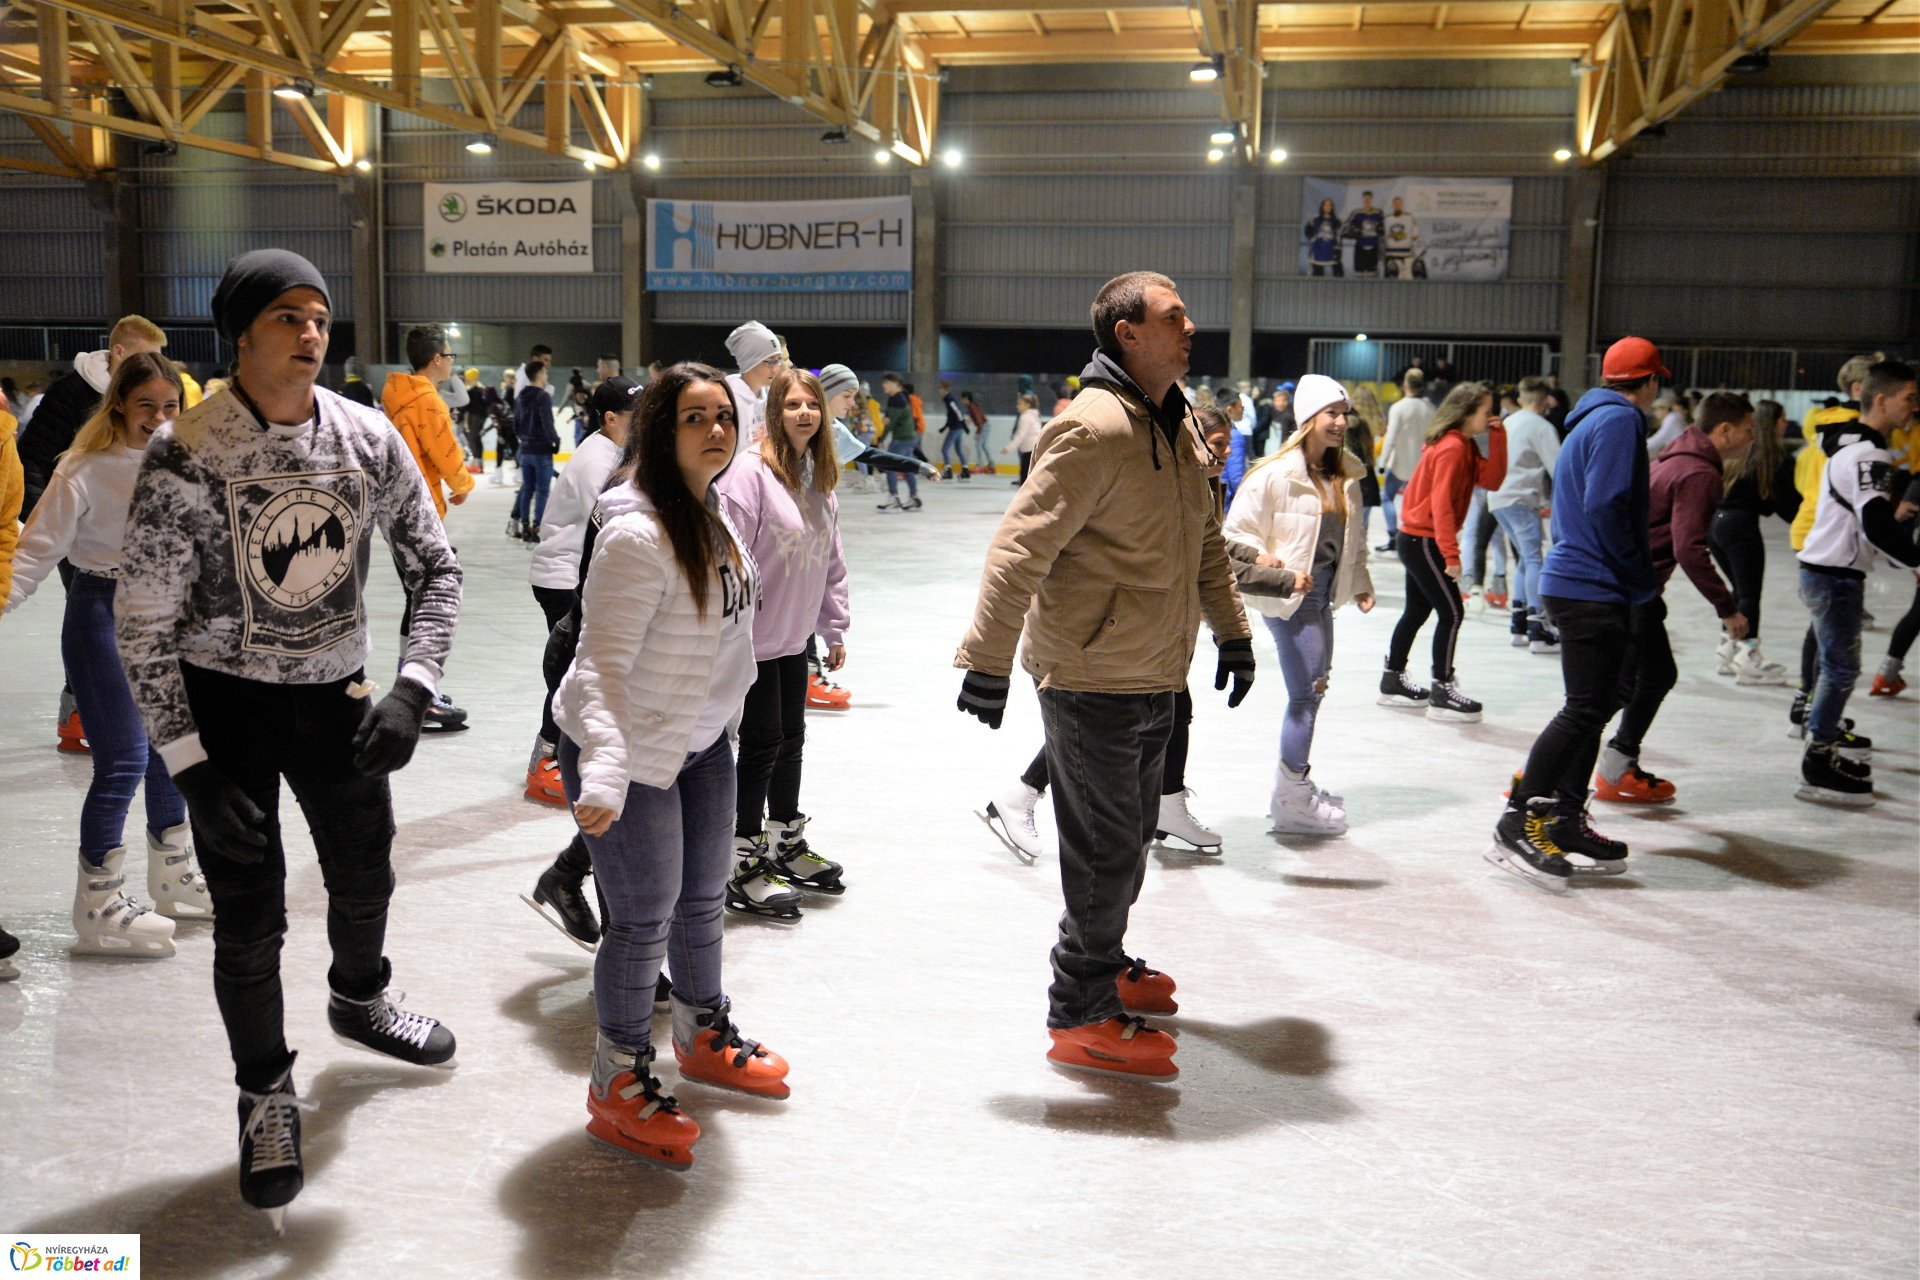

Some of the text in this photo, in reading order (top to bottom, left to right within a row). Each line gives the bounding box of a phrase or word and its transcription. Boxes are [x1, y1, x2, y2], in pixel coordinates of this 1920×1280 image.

[476, 194, 577, 215] ŠKODA
[452, 239, 589, 257] Platán Autóház
[717, 218, 903, 250] HÜBNER-H
[250, 491, 354, 560] FEEL THE BURN
[259, 560, 350, 605] TO THE MAX
